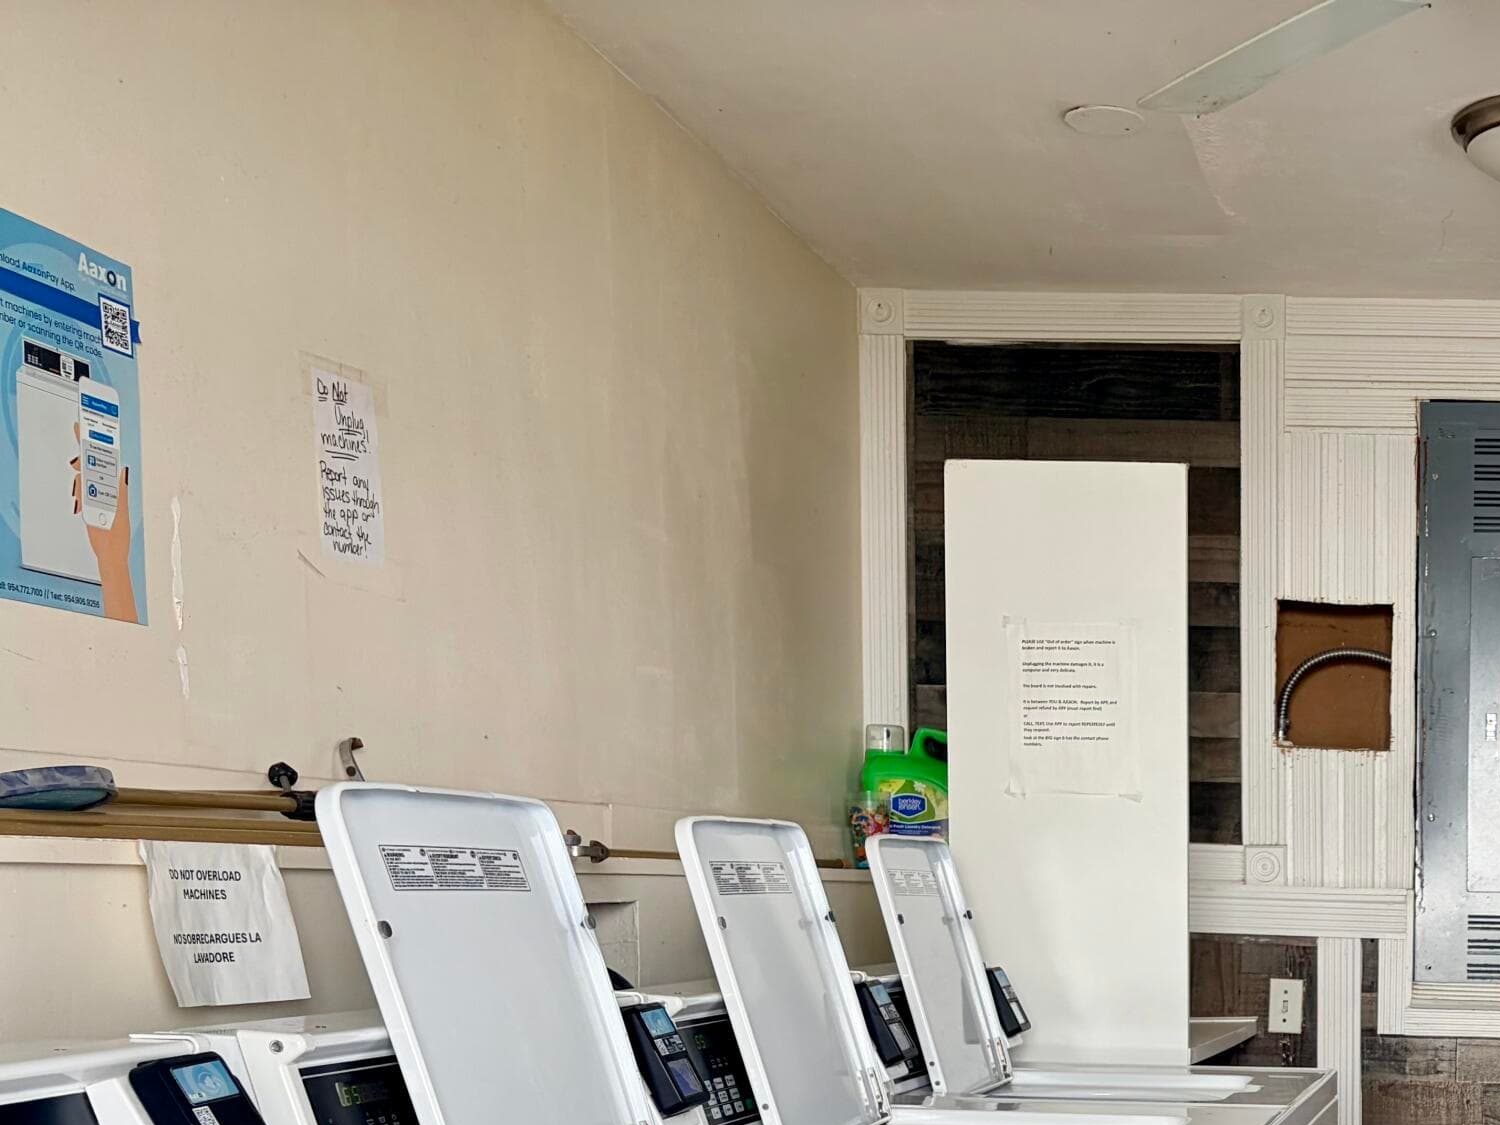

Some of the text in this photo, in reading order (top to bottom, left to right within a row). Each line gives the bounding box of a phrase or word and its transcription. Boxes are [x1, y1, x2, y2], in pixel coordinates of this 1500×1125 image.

[22, 261, 59, 286] AaxonPay
[78, 252, 127, 292] Aaxon
[5, 300, 42, 321] machines
[43, 313, 53, 327] by
[54, 320, 83, 339] entering
[18, 319, 26, 328] or
[28, 322, 60, 345] scanning
[62, 334, 74, 347] the
[75, 339, 84, 351] QR
[332, 381, 349, 402] Not
[319, 460, 369, 492] Report any
[322, 484, 350, 504] issues
[323, 504, 336, 520] the
[340, 507, 359, 525] app
[323, 521, 372, 545] contact the
[169, 869, 242, 881] DO NOT OVERLOAD
[183, 888, 227, 900] MACHINES
[173, 932, 262, 944] NO SOBRECARGUES LA
[194, 952, 236, 964] LAVADORE
